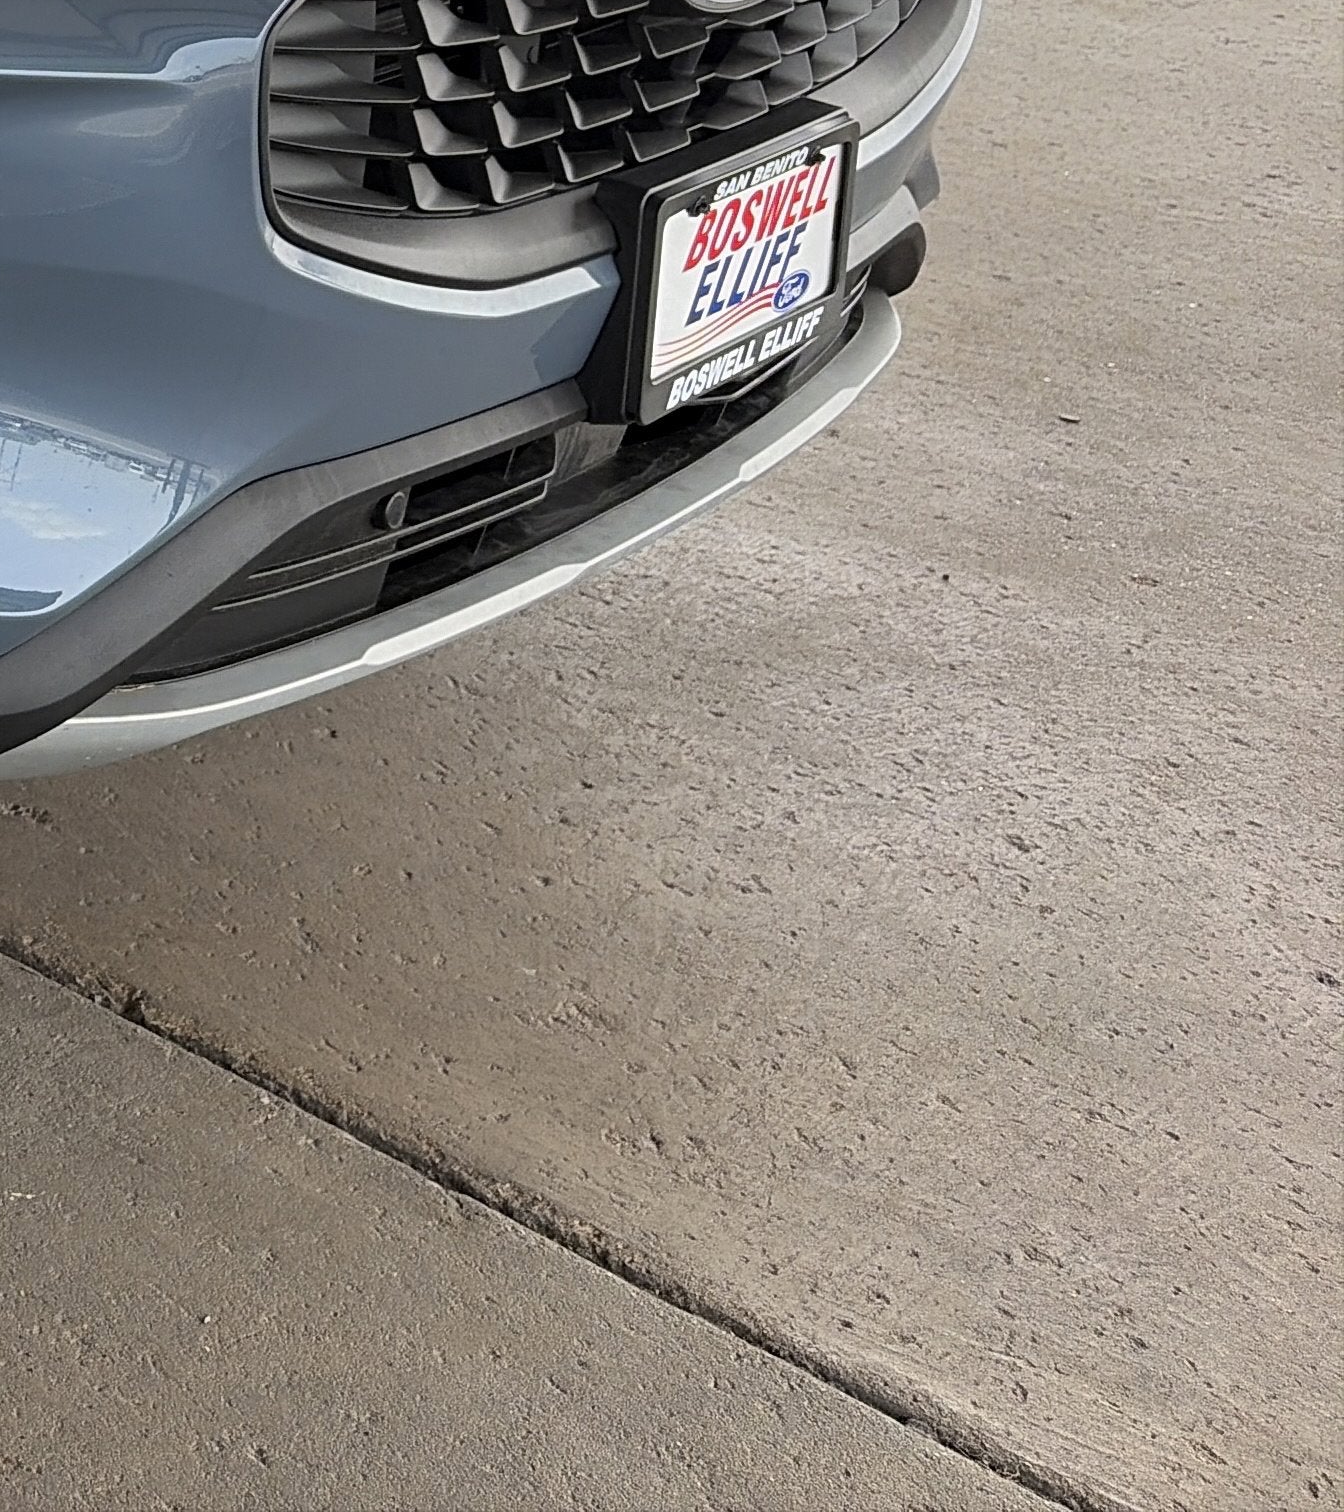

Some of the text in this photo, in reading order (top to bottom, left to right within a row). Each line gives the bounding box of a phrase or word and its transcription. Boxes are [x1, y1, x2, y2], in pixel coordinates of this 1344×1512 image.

[682, 156, 837, 273] BOSWELL
[714, 147, 809, 201] SAN BENITO
[684, 221, 810, 327] ELLIFF
[778, 276, 805, 308] Ford
[665, 306, 825, 411] BOSWELL ELLIFF
